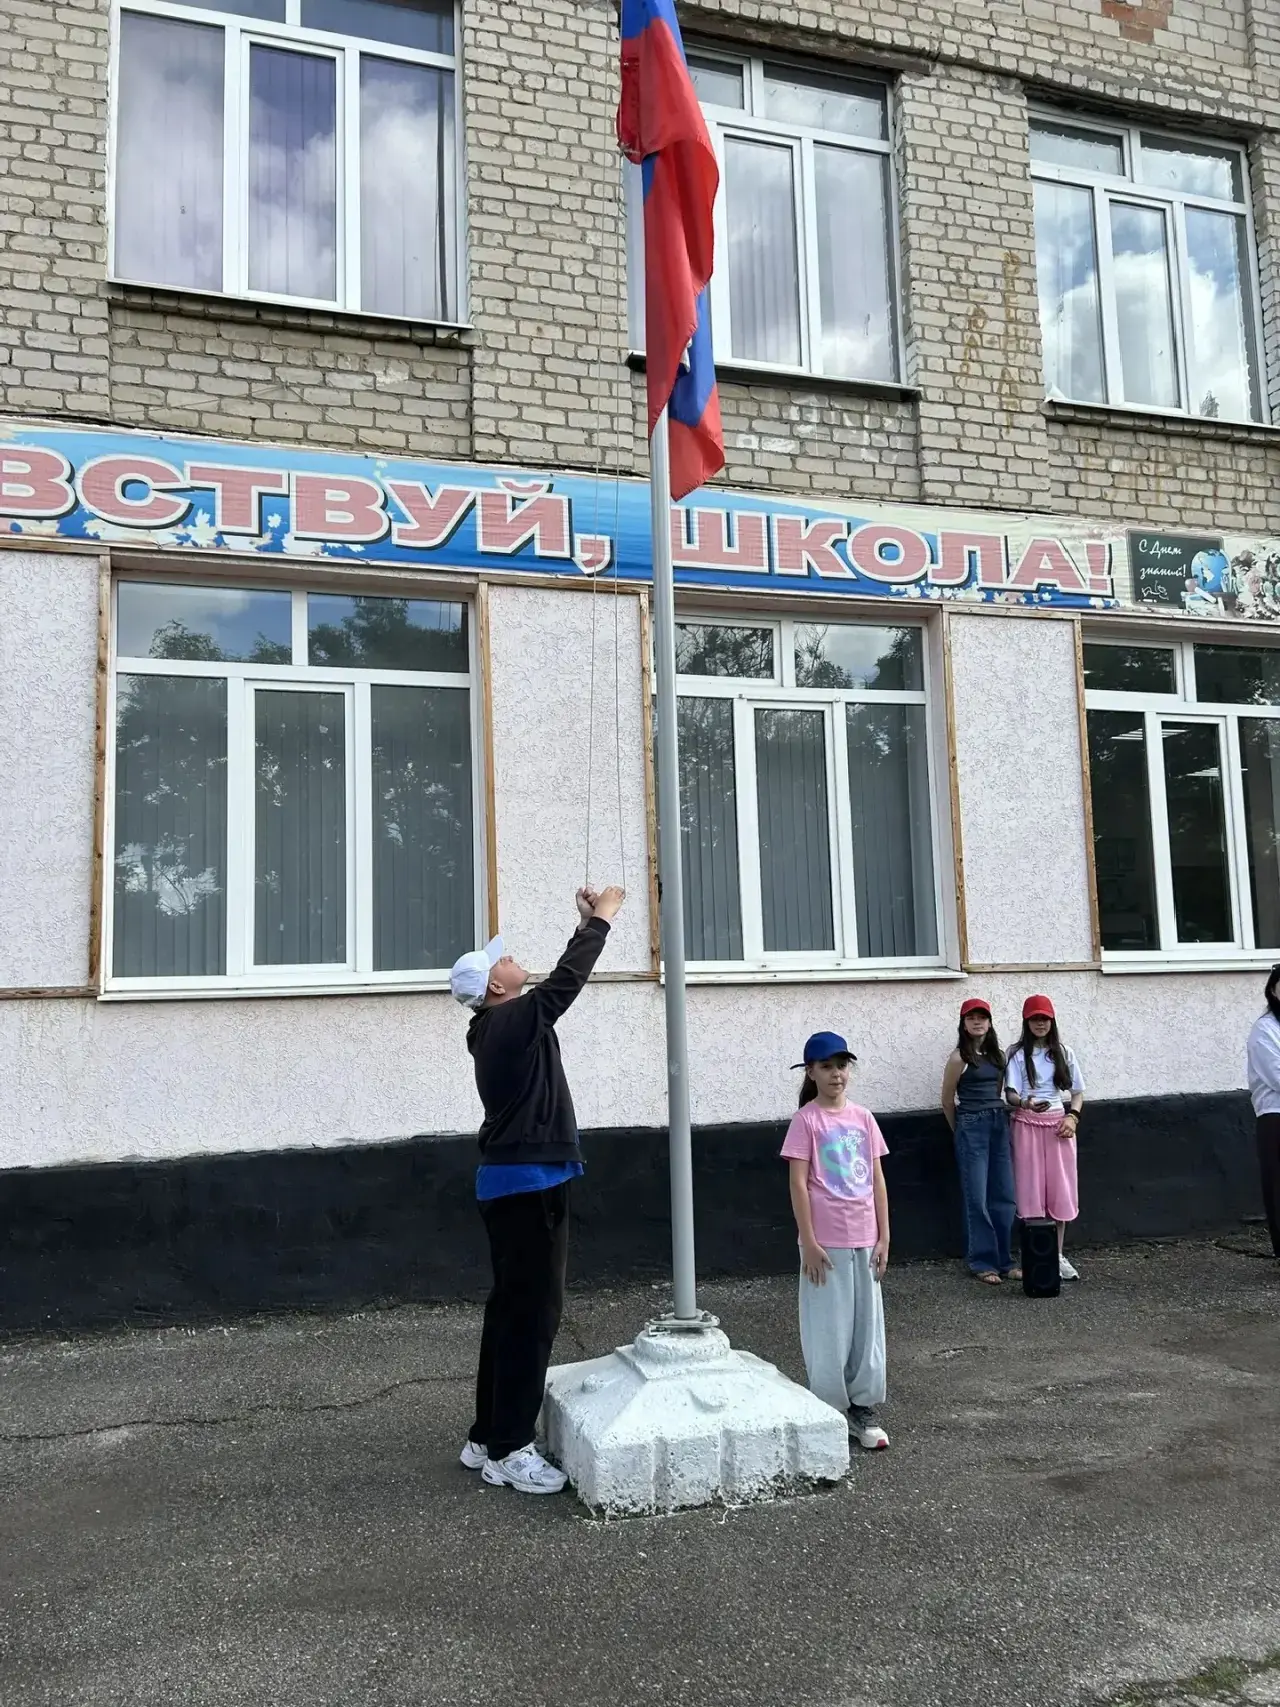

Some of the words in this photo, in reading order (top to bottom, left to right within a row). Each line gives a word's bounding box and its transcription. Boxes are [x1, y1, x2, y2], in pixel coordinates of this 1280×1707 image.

[671, 505, 1112, 597] ШКОЛА!
[1138, 538, 1148, 553] С
[1139, 563, 1187, 580] знаний!
